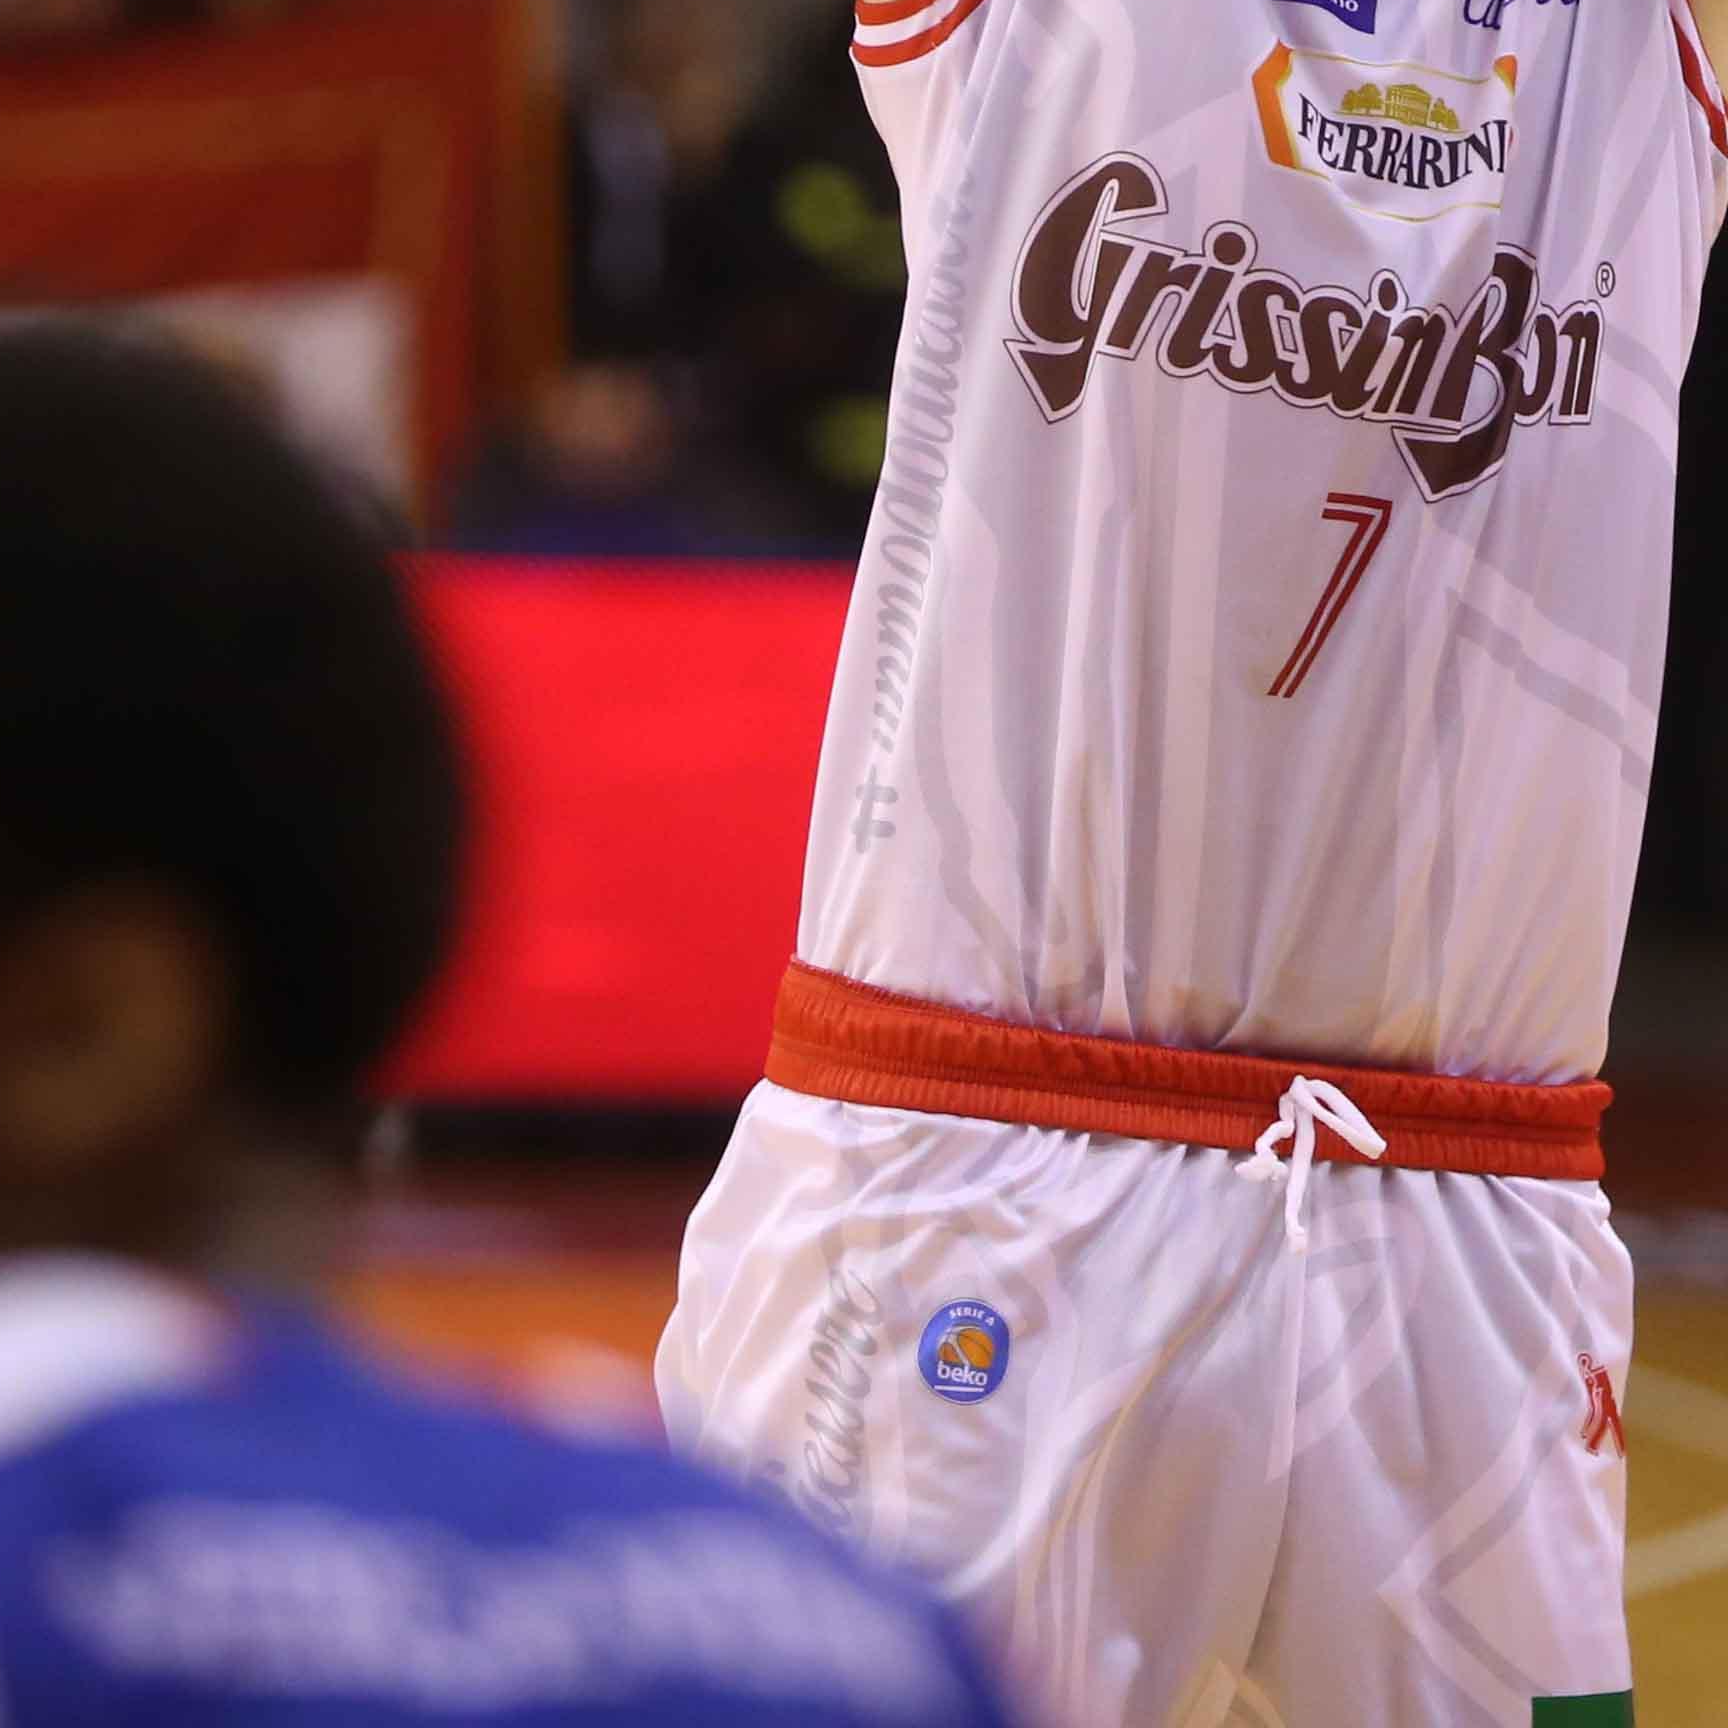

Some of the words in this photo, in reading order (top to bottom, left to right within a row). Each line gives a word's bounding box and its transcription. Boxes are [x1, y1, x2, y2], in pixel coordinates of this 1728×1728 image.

[1297, 92, 1509, 190] FERRARINI
[1003, 150, 1604, 504] GrissinBon
[1267, 492, 1393, 700] 7
[949, 1306, 985, 1320] SERIE
[937, 1360, 988, 1387] beko
